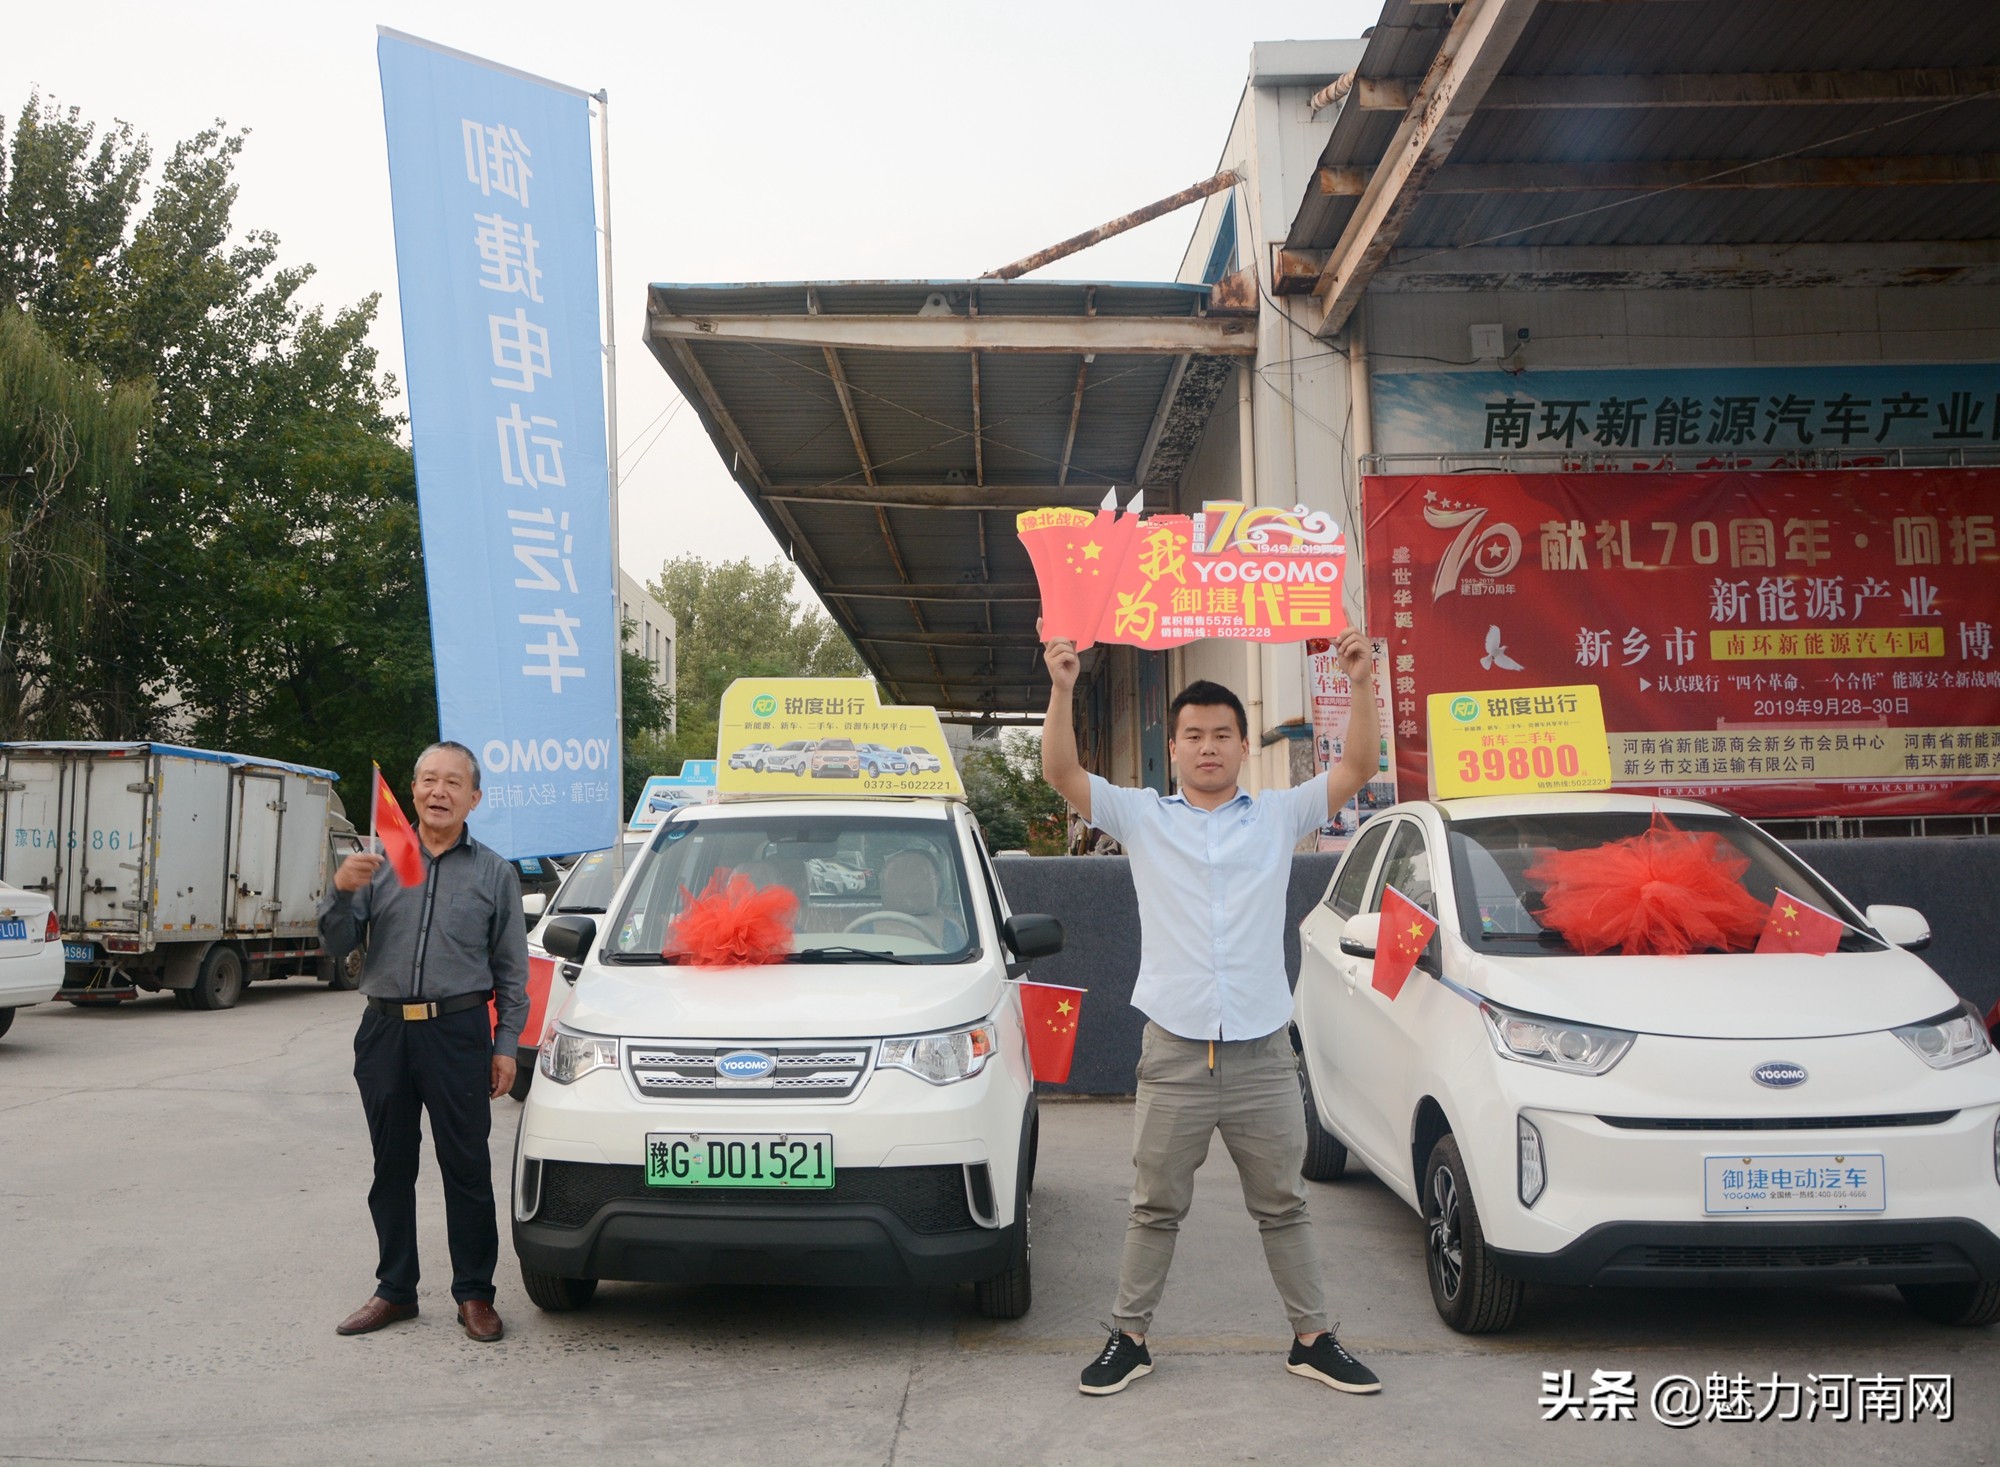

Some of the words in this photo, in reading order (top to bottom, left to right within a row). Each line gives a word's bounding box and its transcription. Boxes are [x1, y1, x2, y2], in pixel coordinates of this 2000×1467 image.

[1484, 391, 2000, 449] 南环新能源汽车产业
[1021, 512, 1090, 531] 豫北战区
[1192, 561, 1338, 583] YOGOMO
[1461, 584, 1516, 595] 建国70周年
[1709, 575, 1942, 623] 新能源产业
[1161, 616, 1243, 626] 累积销售55万台
[1726, 630, 1930, 657] 南环新能源汽车园
[1957, 622, 1994, 661] 博
[784, 697, 866, 716] 锐度出行
[1487, 694, 1578, 717] 锐度出行
[1754, 697, 1910, 716] 2019年9月28-30日
[1624, 734, 1885, 754] 河南省新能源商会新乡市会员中心
[1458, 744, 1580, 783] 39800
[1624, 756, 1815, 775] 新乡市交通运输有限公司
[864, 780, 950, 790] 0373-5022221
[723, 1061, 769, 1071] YOGOMO
[1758, 1069, 1805, 1080] YOGOMO
[1722, 1168, 1868, 1190] 御捷电动汽车
[1722, 1192, 1767, 1200] YOGOMO
